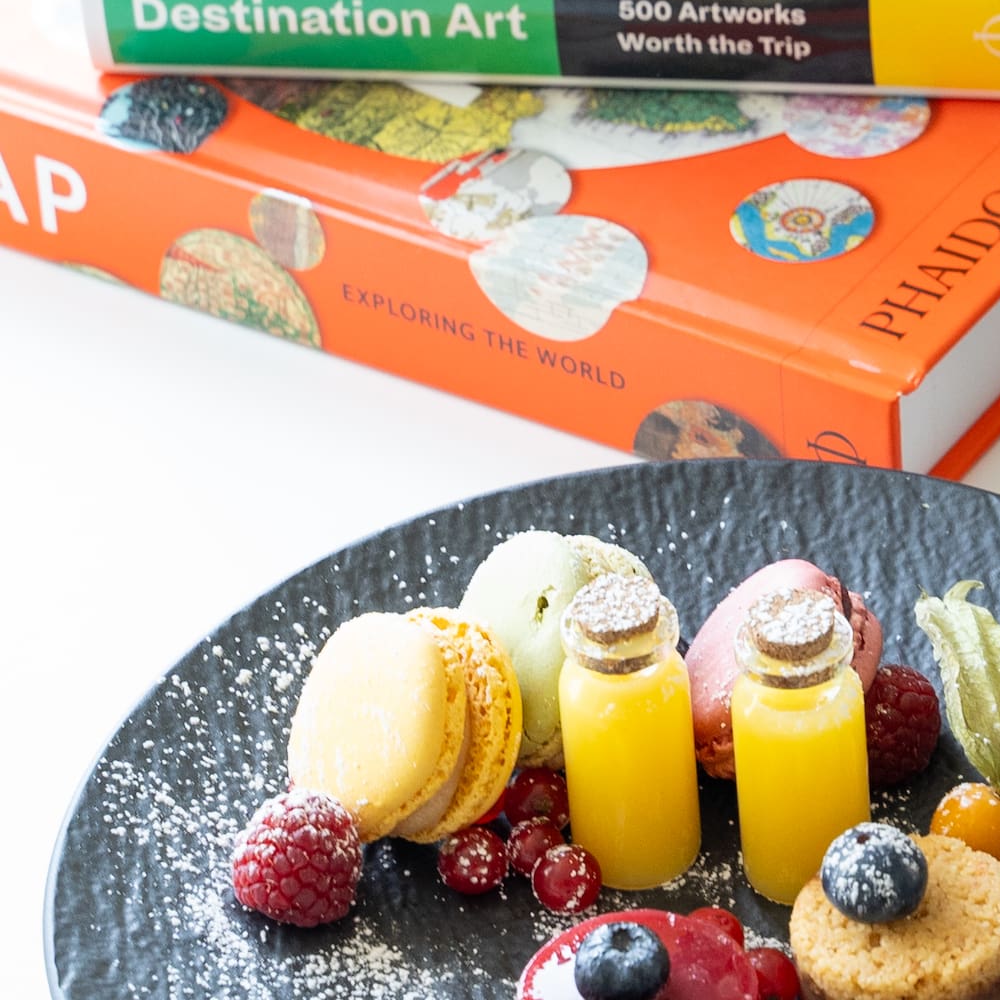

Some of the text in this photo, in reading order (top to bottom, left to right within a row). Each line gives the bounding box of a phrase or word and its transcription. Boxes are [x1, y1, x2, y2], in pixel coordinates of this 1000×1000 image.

[445, 2, 529, 41] Art
[677, 0, 808, 27] Artworks
[616, 31, 812, 62] Worth the Trip
[341, 283, 627, 391] EXPLORING THE WORLD
